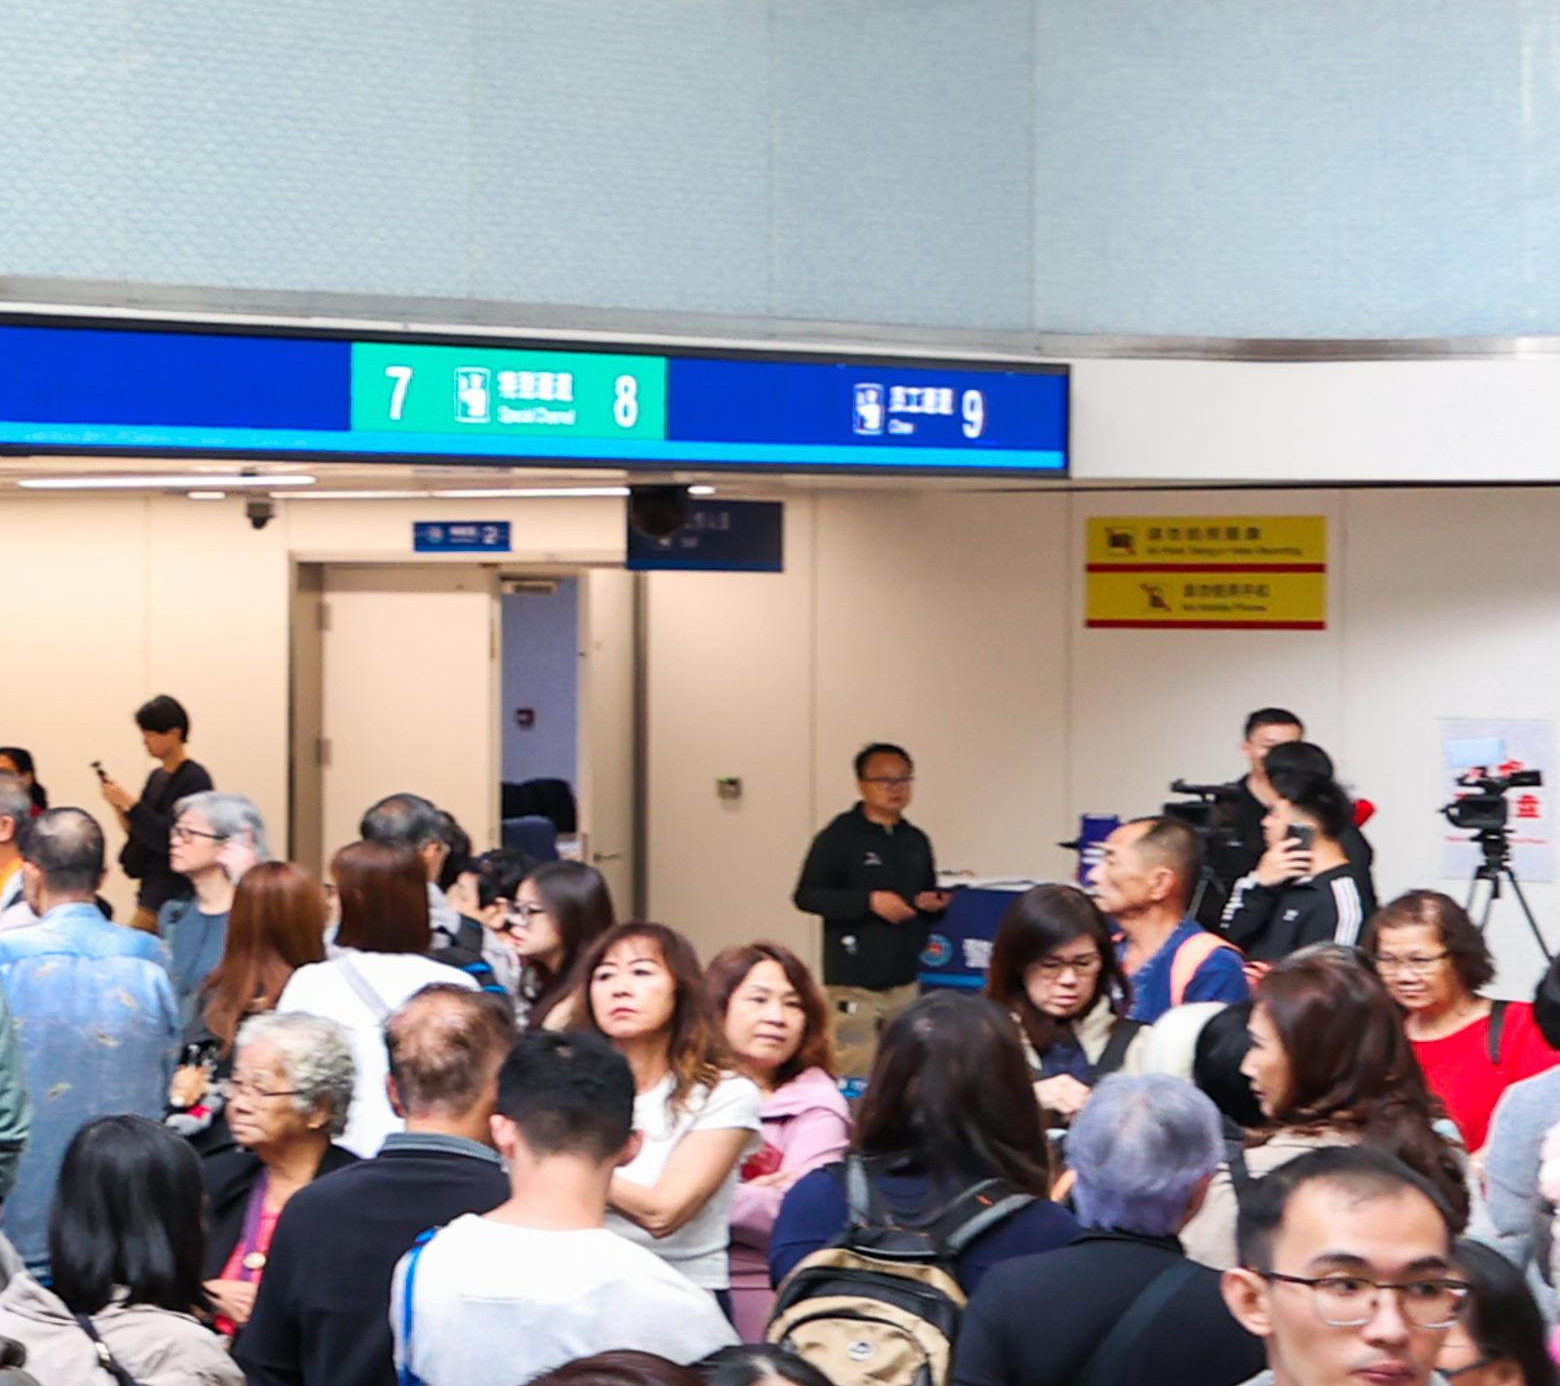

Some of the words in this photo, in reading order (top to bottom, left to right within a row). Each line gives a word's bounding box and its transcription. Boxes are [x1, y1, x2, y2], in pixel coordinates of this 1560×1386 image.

[384, 365, 413, 421] 7
[613, 374, 639, 428] 8
[961, 389, 984, 439] 9
